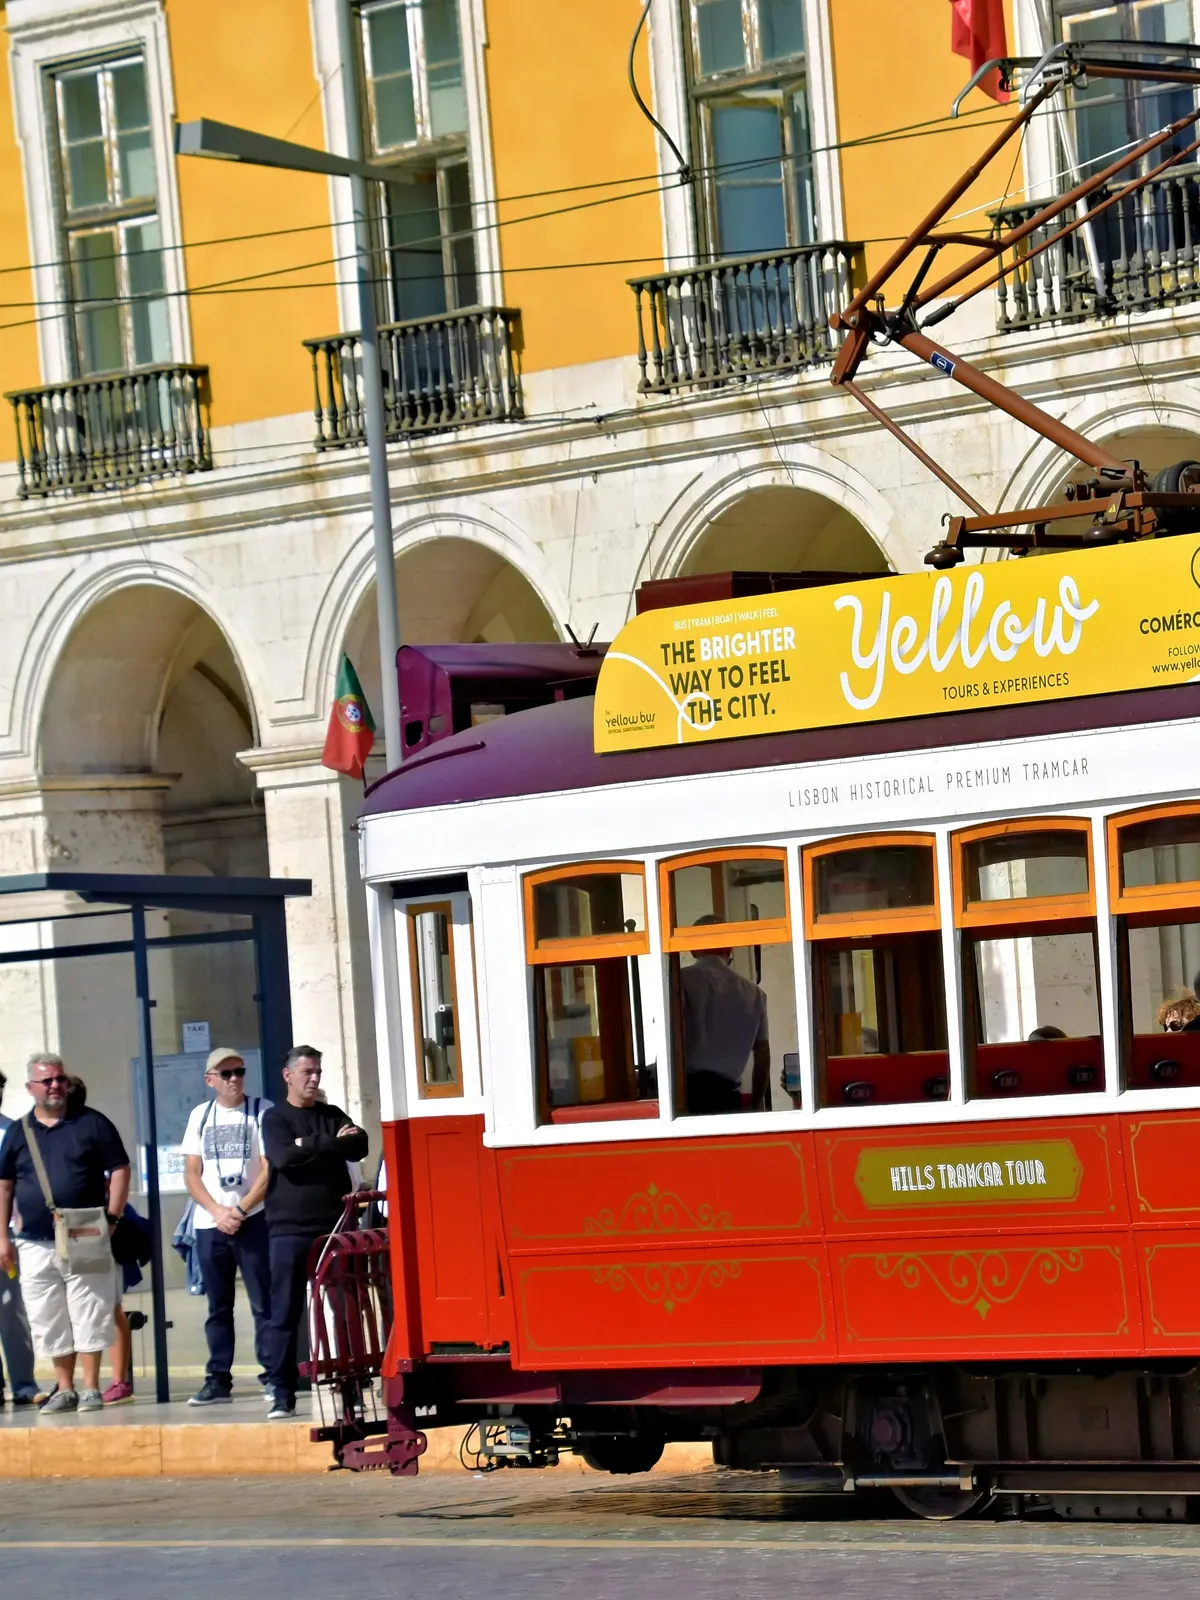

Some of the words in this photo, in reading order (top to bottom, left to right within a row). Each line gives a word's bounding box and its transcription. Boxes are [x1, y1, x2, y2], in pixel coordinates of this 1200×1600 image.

[660, 640, 696, 666] THE
[699, 626, 796, 661] BRIGHTER
[833, 571, 1100, 711] Yellow
[669, 668, 712, 695] WAY
[717, 665, 744, 689] TO
[748, 659, 791, 686] FEEL
[942, 683, 980, 700] TOURS
[982, 682, 991, 696] &
[993, 672, 1070, 694] EXPERIENCES
[639, 711, 656, 723] bus
[687, 698, 722, 724] THE
[727, 692, 776, 719] CITY.
[788, 786, 839, 807] LISBON
[850, 775, 935, 801] HISTORICAL
[946, 766, 1011, 790] PREMIUM
[1022, 757, 1090, 781] TRAMCAR
[890, 1165, 936, 1192] HILLS
[937, 1162, 1004, 1189] TRAMCAR
[1005, 1159, 1047, 1186] TOUR
